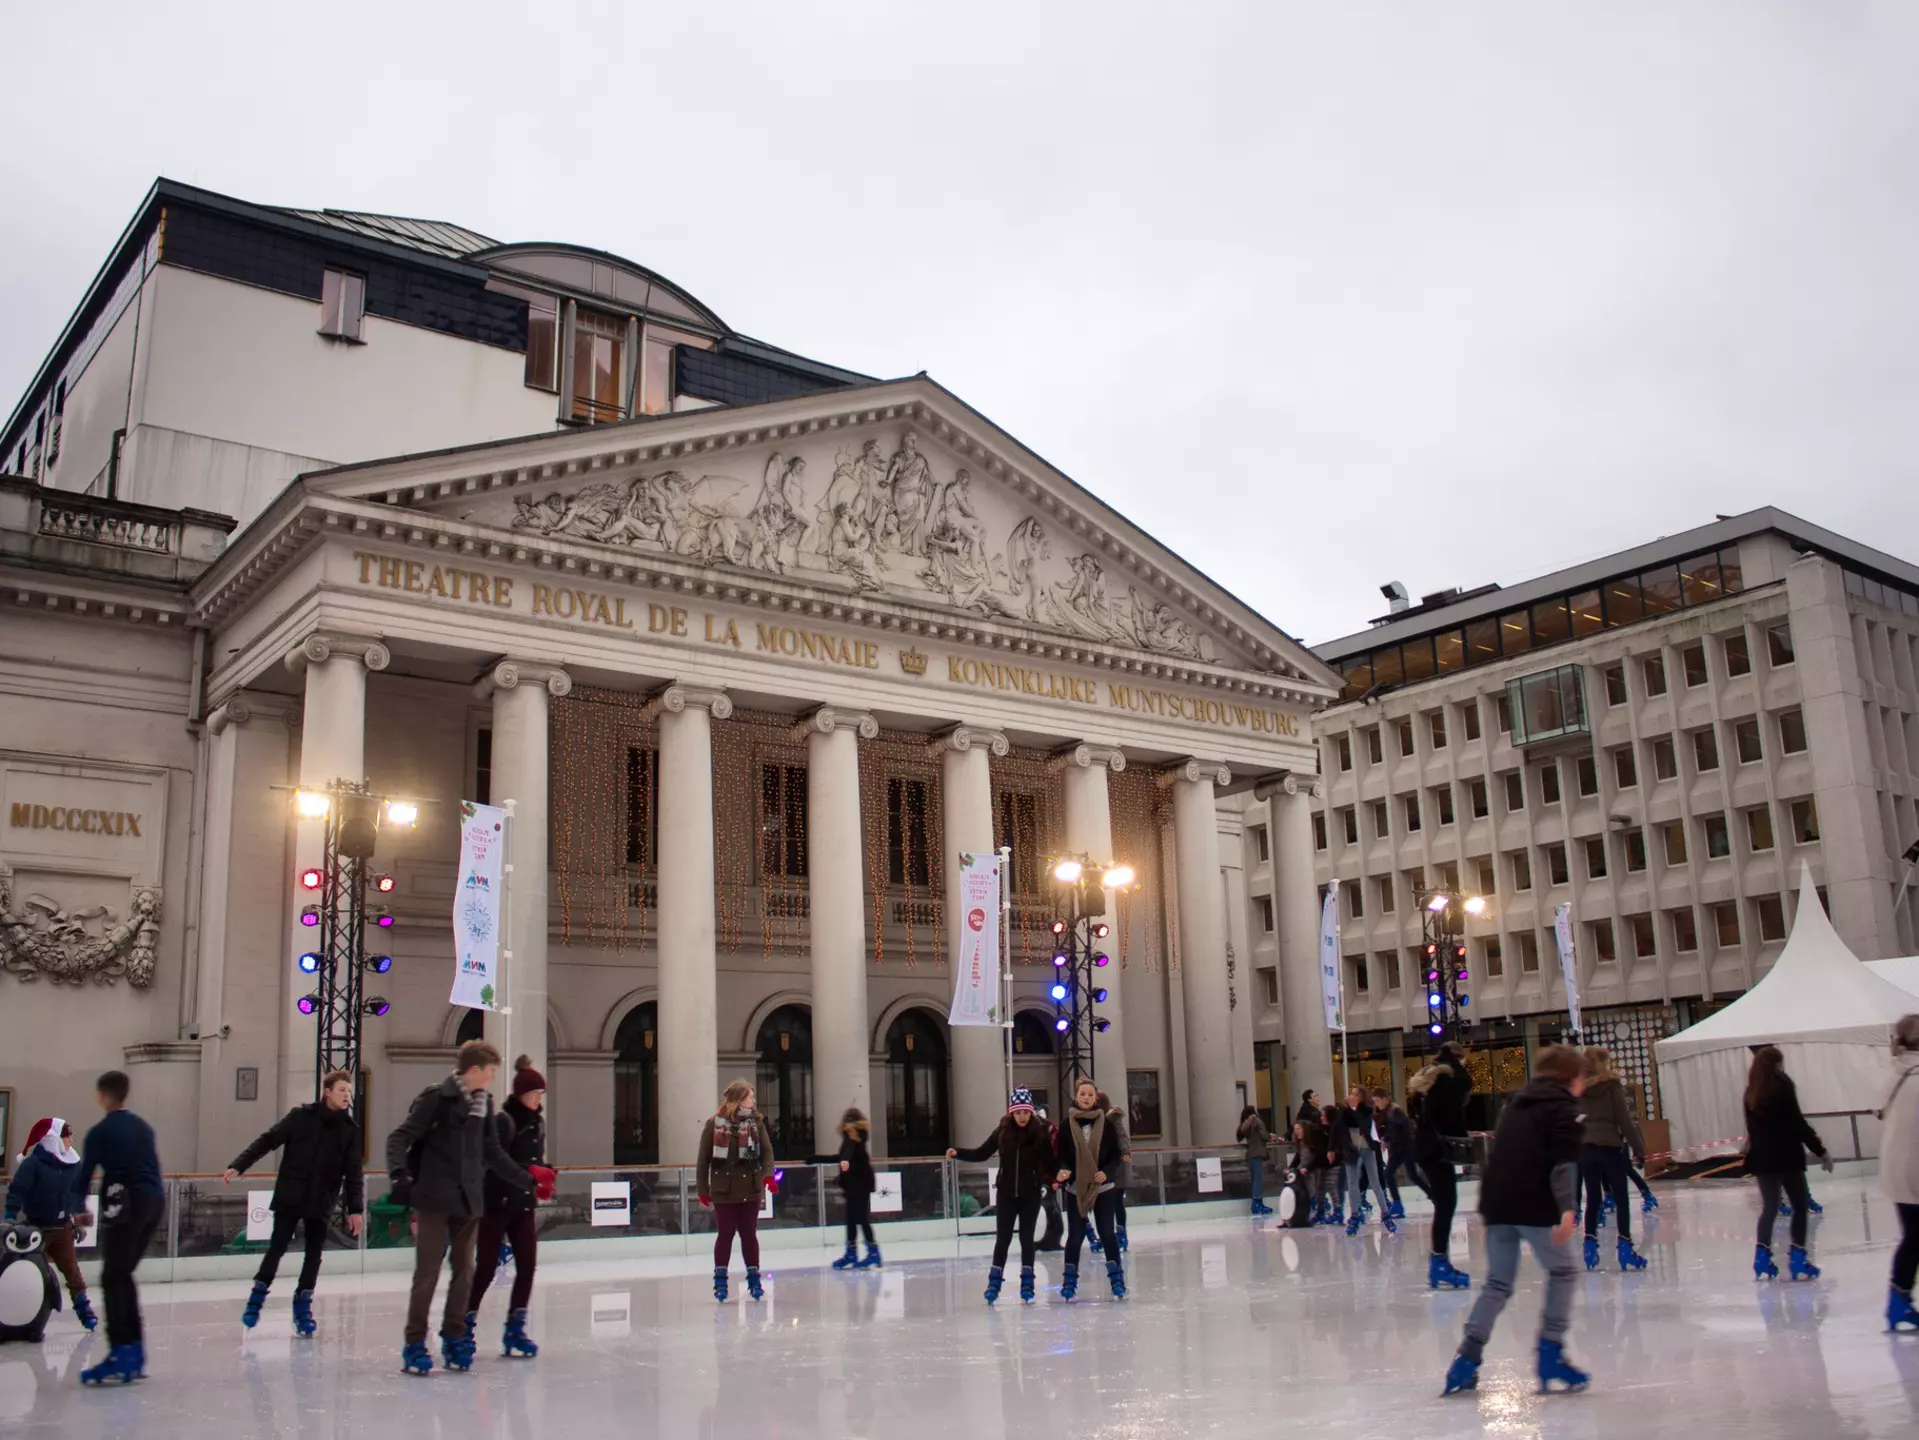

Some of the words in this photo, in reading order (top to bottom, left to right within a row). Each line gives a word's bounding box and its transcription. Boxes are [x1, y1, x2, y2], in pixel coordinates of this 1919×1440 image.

[353, 551, 514, 608] THEATRE
[532, 583, 634, 630] ROYAL
[649, 604, 689, 638] DE
[704, 613, 741, 647] LA
[756, 621, 881, 670] MONNAIE
[947, 654, 1098, 705] KONINKLIJKE
[1108, 682, 1300, 738] MUNTSCHOUWBURG
[10, 802, 143, 837] MDCCCXIX
